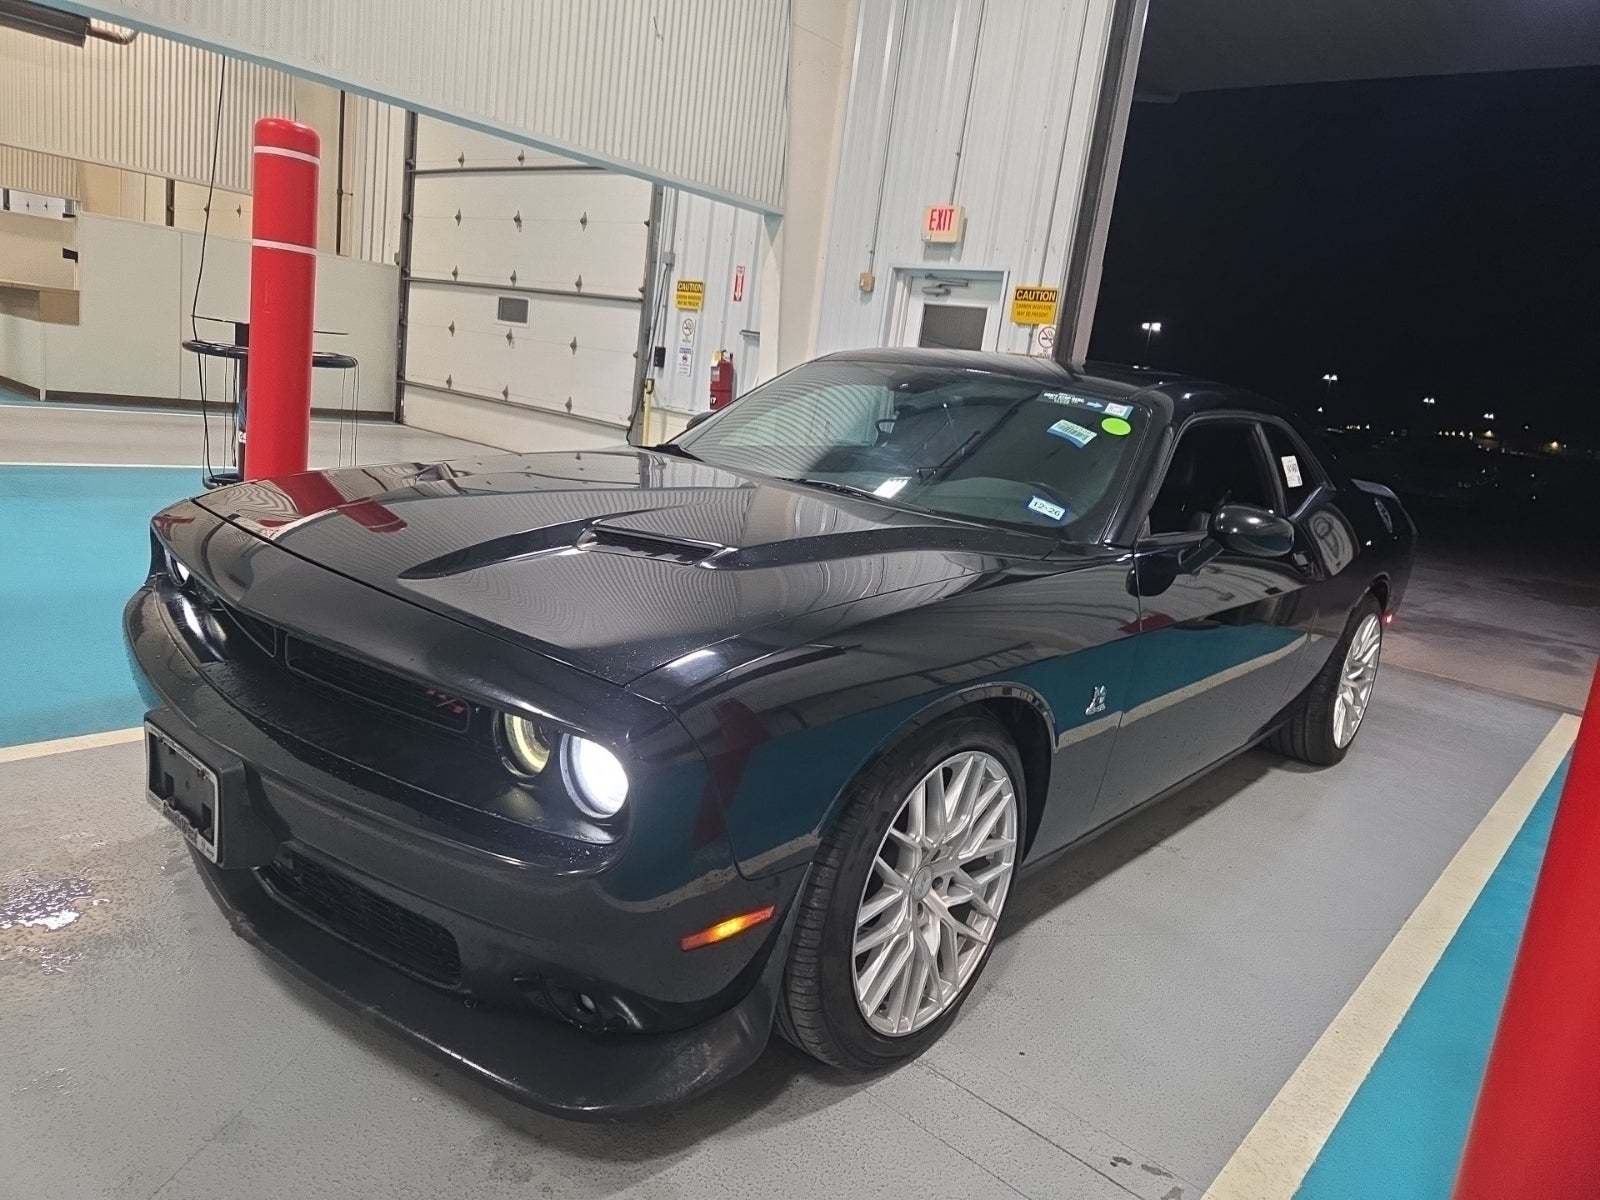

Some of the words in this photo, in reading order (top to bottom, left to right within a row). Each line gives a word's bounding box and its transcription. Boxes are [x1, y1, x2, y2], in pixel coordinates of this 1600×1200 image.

[928, 208, 955, 232] EXIT
[677, 282, 703, 293] CAUTION
[1016, 289, 1057, 302] CAUTION
